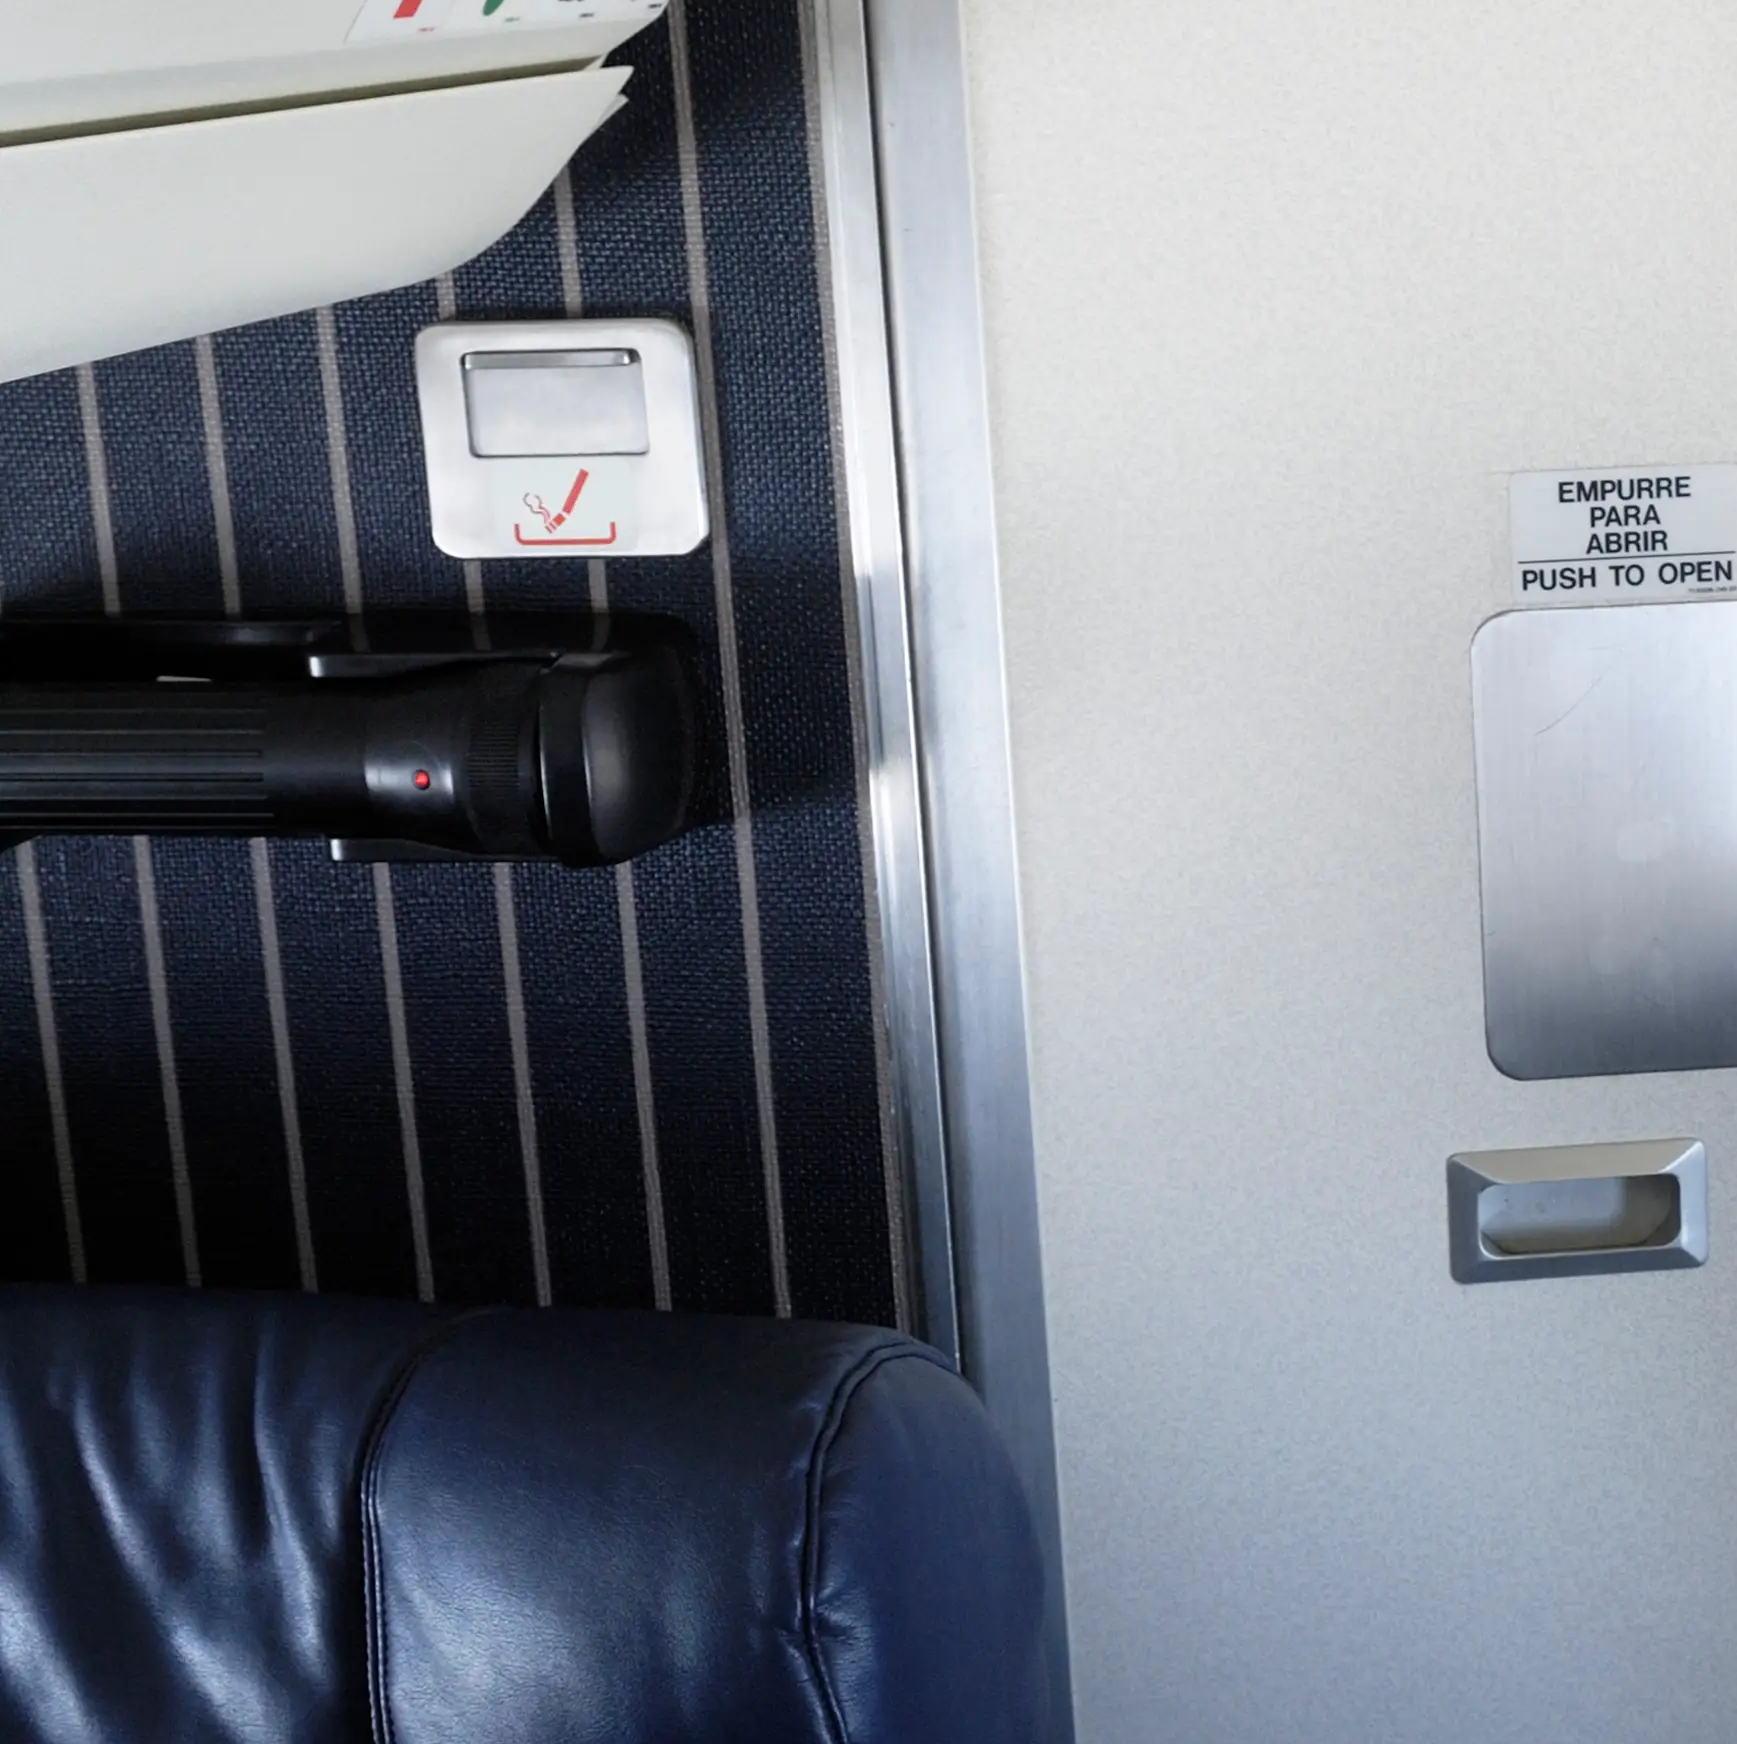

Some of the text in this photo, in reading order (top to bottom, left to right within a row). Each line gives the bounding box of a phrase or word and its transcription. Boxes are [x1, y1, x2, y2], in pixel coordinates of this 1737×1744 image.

[1558, 476, 1691, 503] EMPURRE
[1590, 504, 1661, 528] PARA
[1586, 530, 1668, 555] ABRIR
[1522, 561, 1732, 590] PUSH TO OPEN
